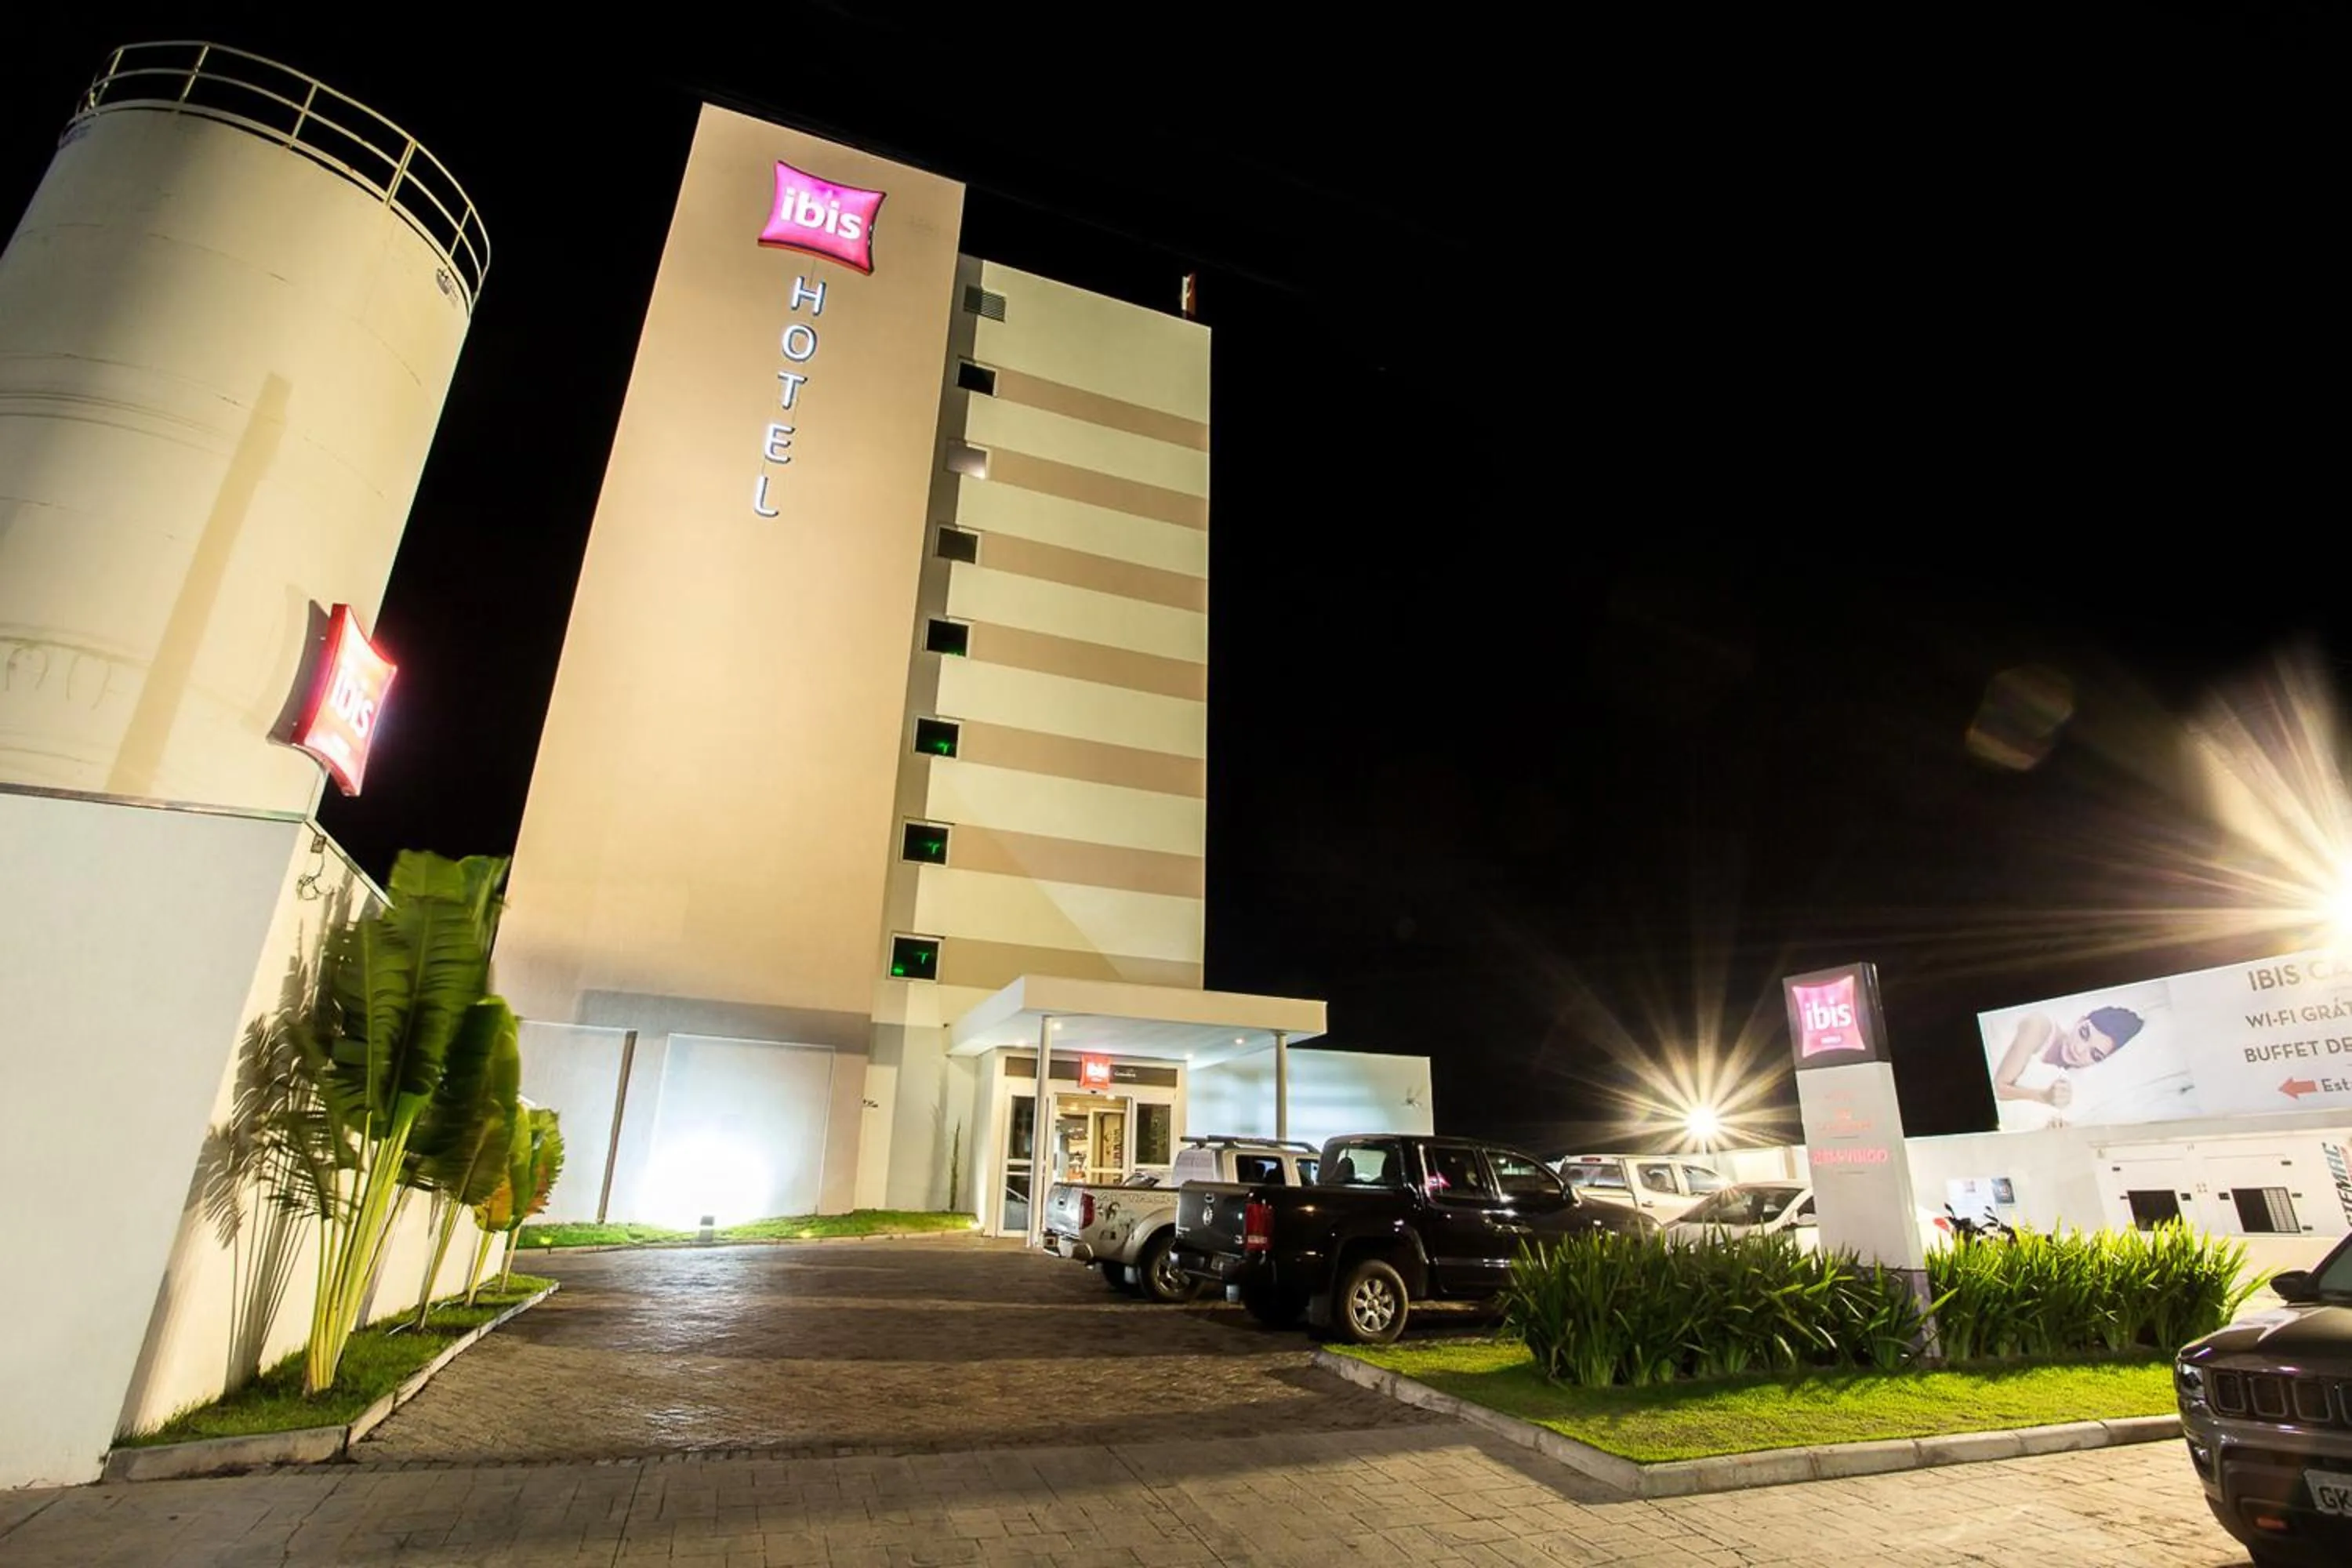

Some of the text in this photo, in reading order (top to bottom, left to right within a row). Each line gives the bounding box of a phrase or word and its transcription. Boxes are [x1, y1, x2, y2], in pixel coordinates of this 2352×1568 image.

[781, 187, 862, 239] ibis
[754, 276, 827, 518] HOTEL
[2247, 964, 2301, 992] IBIS
[1805, 994, 1852, 1032] ibis
[2245, 1009, 2296, 1028] WI-FI
[2244, 1040, 2318, 1062] BUFFET
